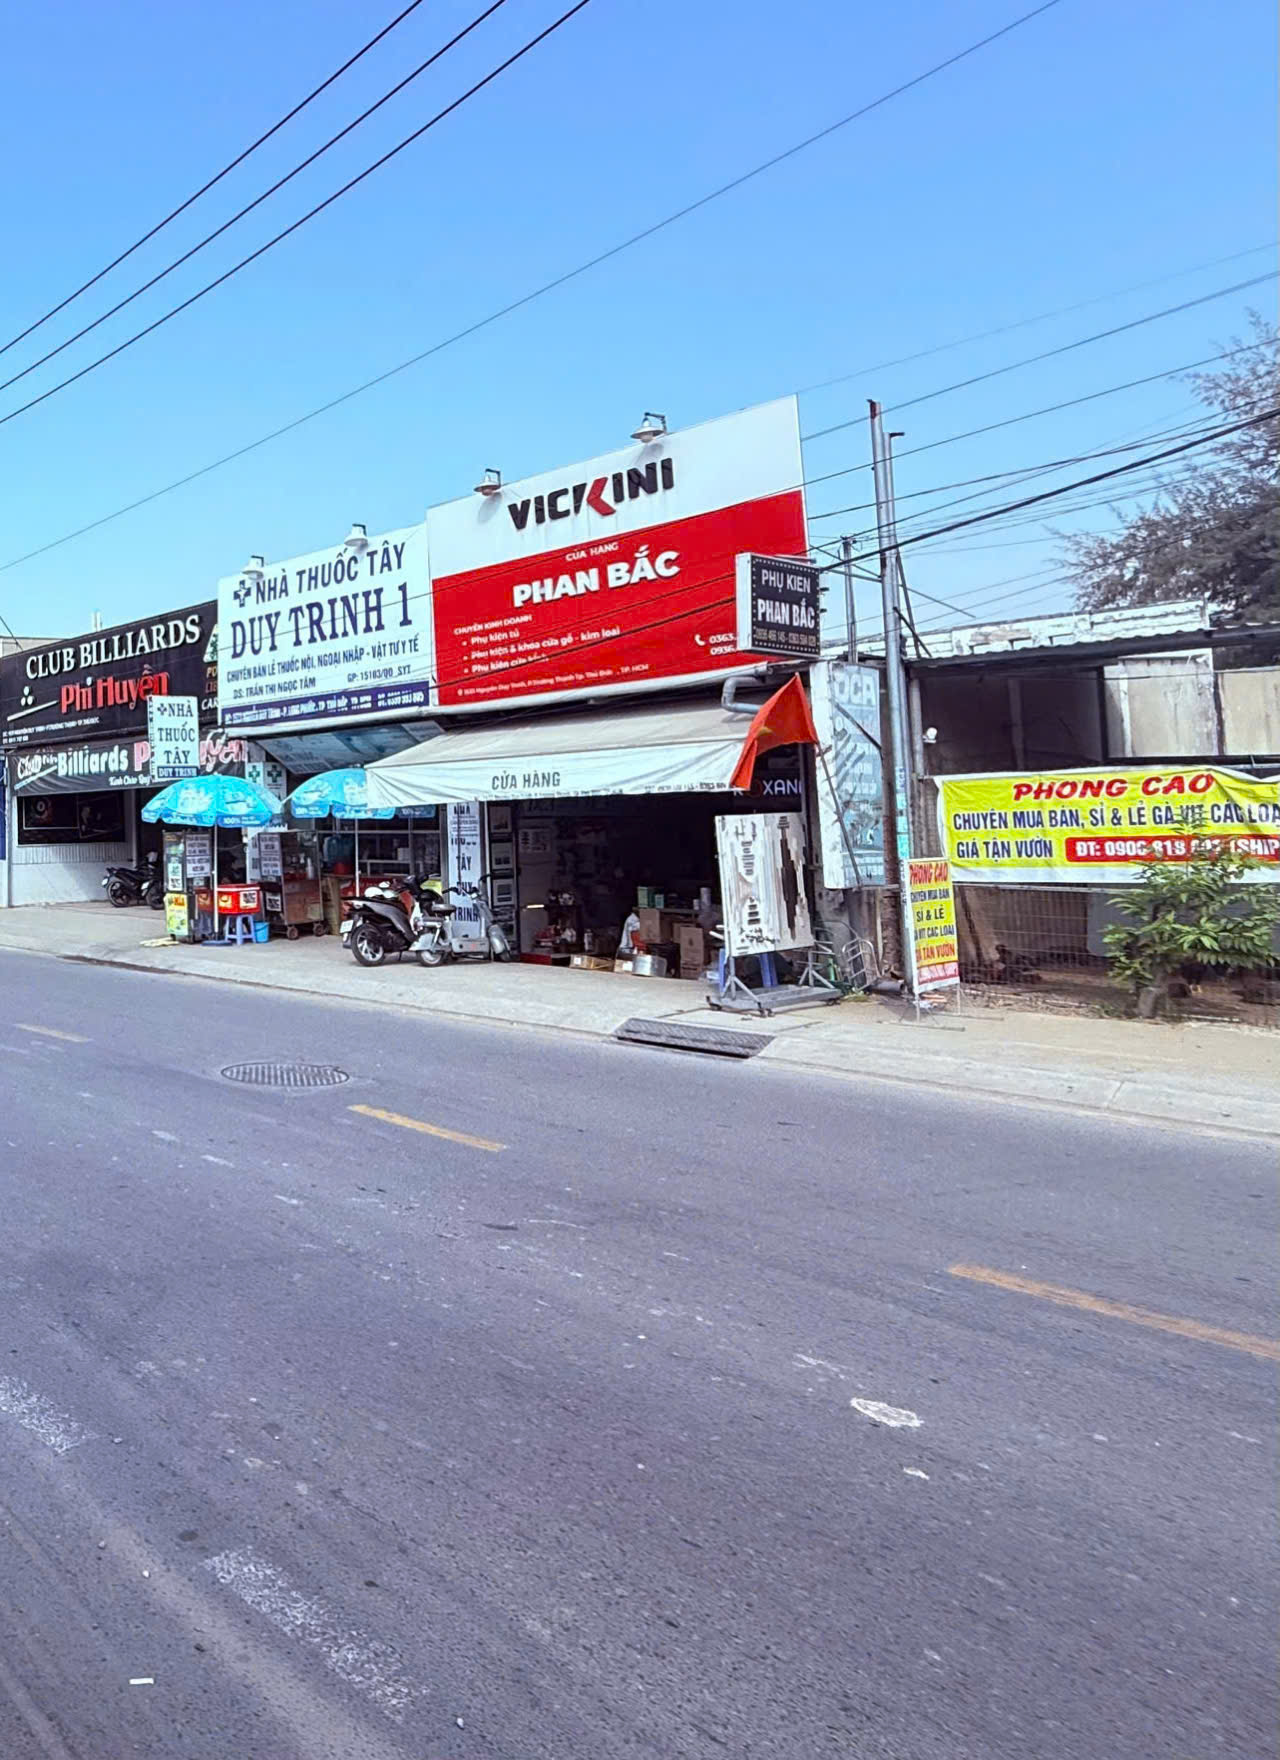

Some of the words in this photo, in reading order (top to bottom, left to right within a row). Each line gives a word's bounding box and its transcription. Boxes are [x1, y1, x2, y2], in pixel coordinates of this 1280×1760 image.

[507, 457, 675, 531] VICKINI
[255, 568, 289, 605] NHÀ
[295, 547, 359, 594] THUỐC
[366, 540, 406, 577] TÂY
[512, 567, 600, 608] PHAN
[607, 544, 681, 590] BẮC
[761, 568, 785, 593] PHỤ
[230, 610, 282, 660] DUY
[287, 586, 386, 648] TRINH
[397, 581, 413, 628] 1
[757, 598, 790, 625] PHAN
[791, 597, 816, 629] BẮC
[26, 648, 77, 680] CLUB
[79, 614, 202, 669] BILLIARDS
[60, 676, 95, 714] Phi
[96, 664, 170, 711] Huyền
[168, 700, 194, 717] NHÀ
[157, 721, 196, 742] THUỐC
[58, 745, 129, 777] Billiards
[164, 747, 191, 765] TÂY
[158, 767, 173, 778] DUY
[175, 767, 198, 777] TRINH
[491, 770, 517, 790] CỬA
[522, 769, 561, 789] HÀNG
[1013, 777, 1128, 801] PHONG
[1141, 773, 1215, 796] CAO
[953, 808, 1008, 831] CHUYÊN
[1012, 810, 1045, 829] MUA
[1090, 801, 1105, 827] SỈ
[1111, 807, 1123, 826] &
[1128, 800, 1147, 826] LẺ
[1152, 801, 1176, 825] GÀ
[1210, 798, 1244, 824] CÁC
[956, 837, 980, 859] GIÁ
[983, 836, 1011, 862] TẬN
[1014, 835, 1054, 858] VƯỜN
[1075, 841, 1101, 857] ĐT:
